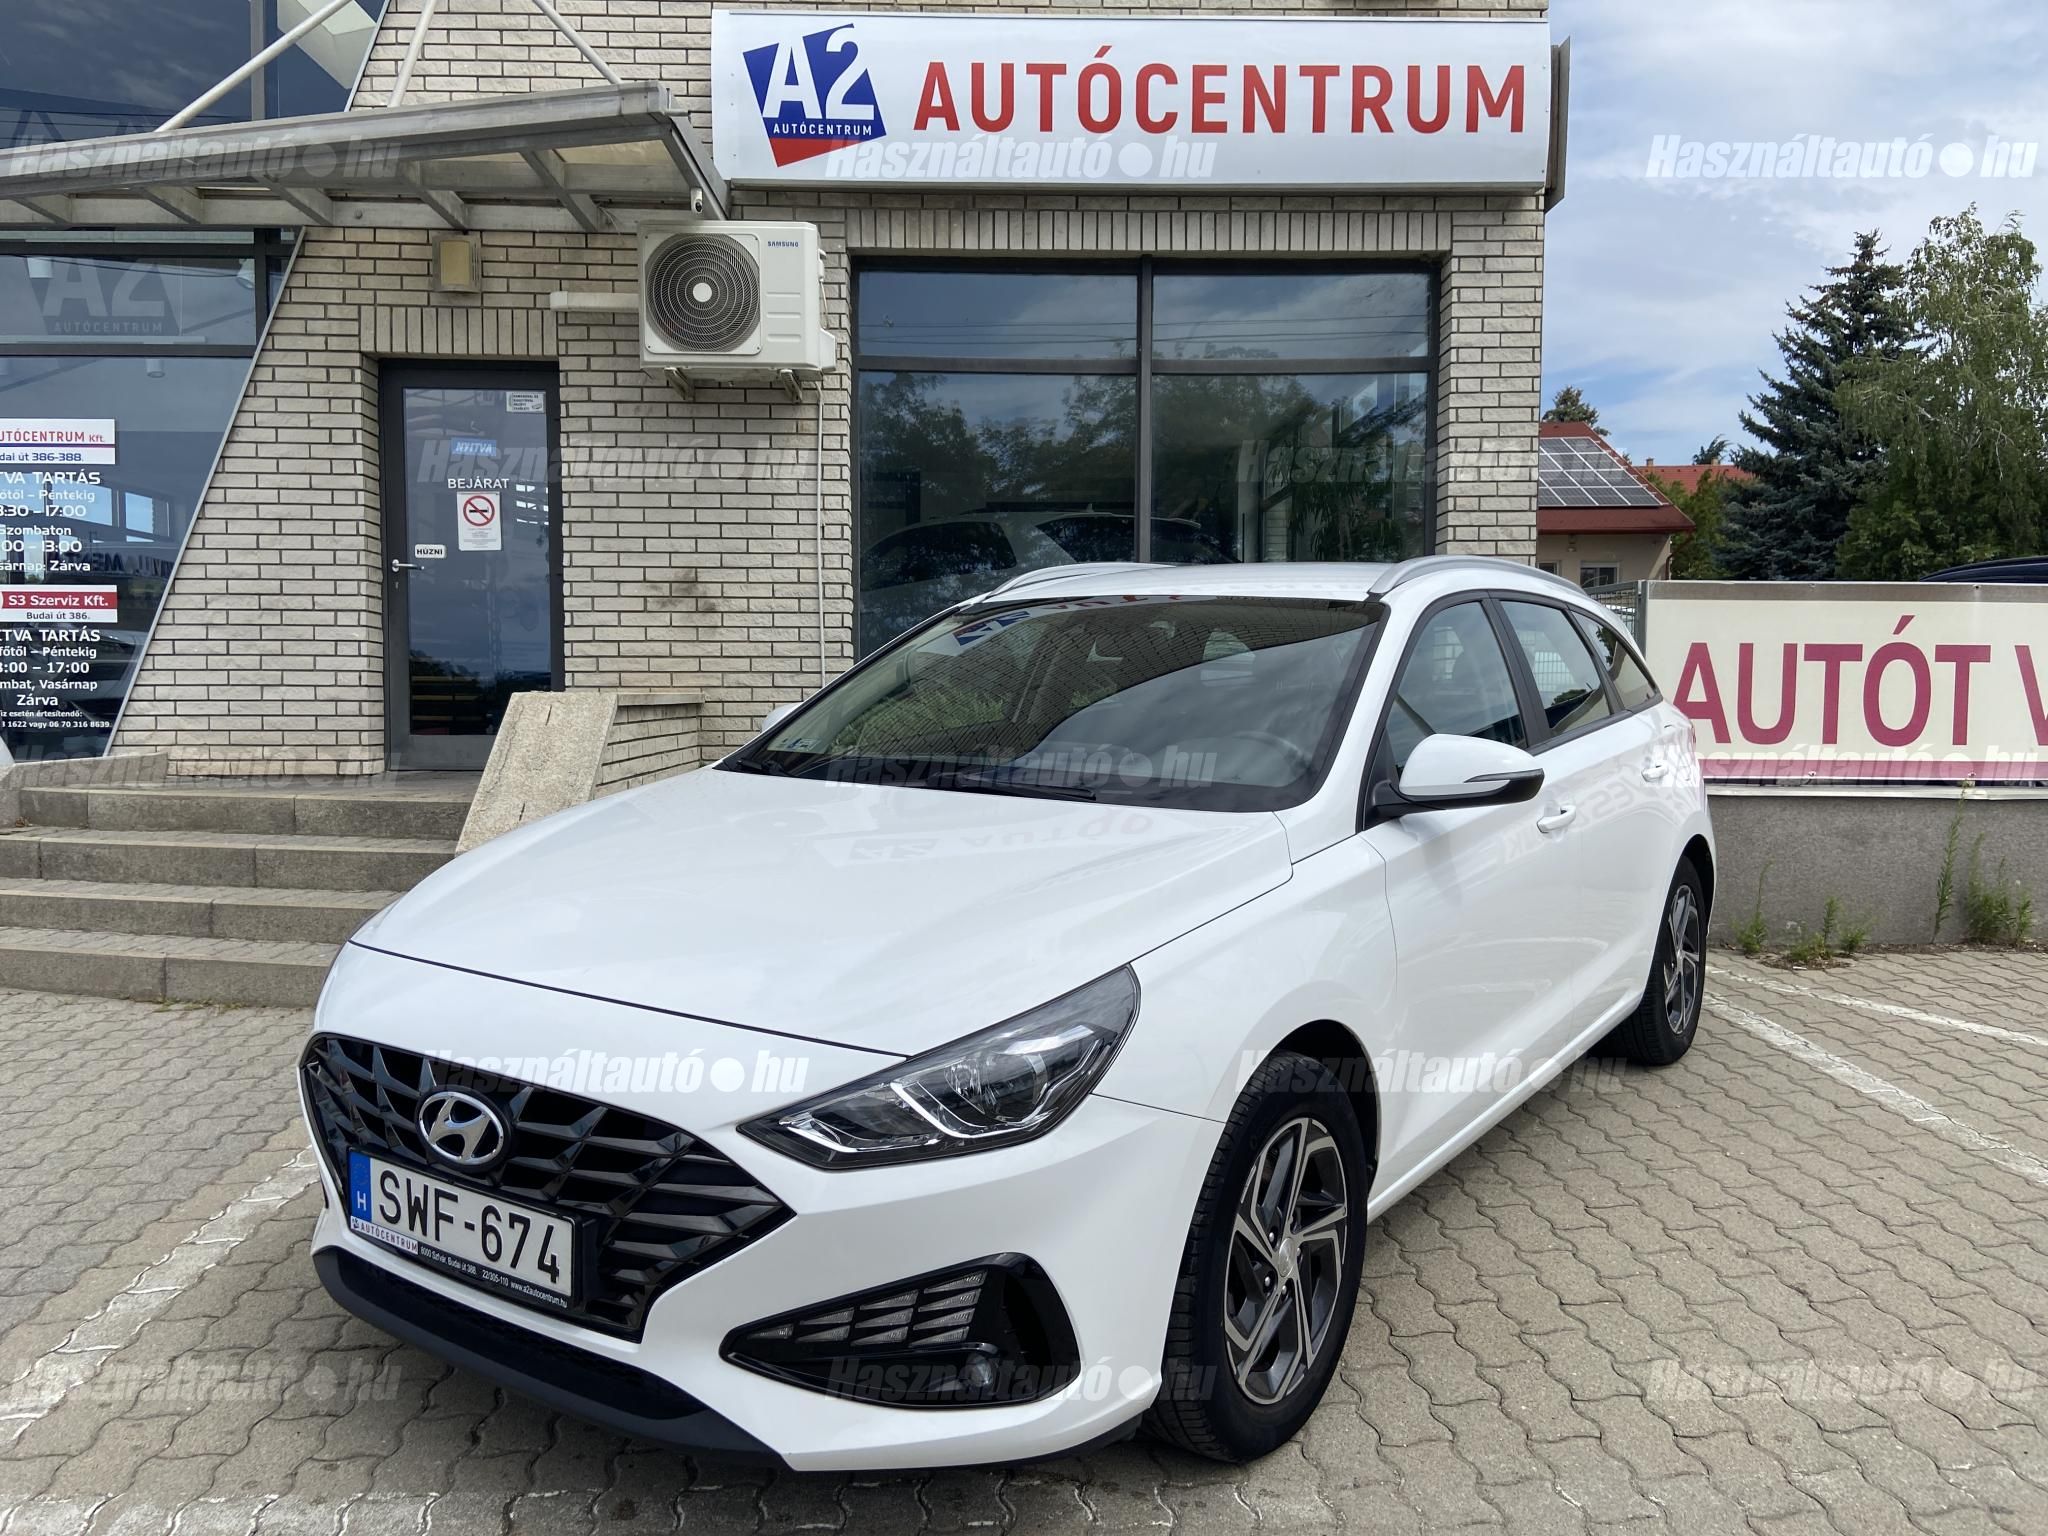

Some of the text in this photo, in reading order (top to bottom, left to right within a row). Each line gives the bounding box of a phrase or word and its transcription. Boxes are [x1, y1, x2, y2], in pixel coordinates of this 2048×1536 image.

[762, 28, 874, 120] A2
[914, 46, 1524, 134] AUTÓCENTRUM
[773, 122, 872, 136] AUTÓCENTRUM
[455, 442, 492, 453] NYITVA
[18, 452, 30, 461] út
[32, 452, 84, 462] 386-388.
[32, 468, 101, 485] TARTÁS
[448, 476, 510, 489] BEJÁRAT
[39, 488, 96, 503] Péntekig
[46, 505, 87, 517] 17:00
[42, 540, 83, 553] 13:00
[416, 546, 443, 556] HÚZNI
[50, 560, 91, 572] Zárva
[8, 595, 109, 607] S3 Szerviz Kft.
[26, 611, 91, 620] Budai út 386.
[0, 625, 101, 642] TVA TARTÁS
[43, 645, 97, 659] Péntekig
[47, 662, 90, 674] 17:00
[39, 678, 98, 692] Vasárnap
[1673, 615, 1992, 747] AUTÓT
[16, 693, 59, 706] Zárva
[29, 722, 47, 730] vagy
[357, 1191, 367, 1212] H
[379, 1170, 560, 1284] SWF-674
[361, 1223, 418, 1252] AUTÓCENTRUM
[511, 1281, 568, 1309] www.a2autocentrum.hu
